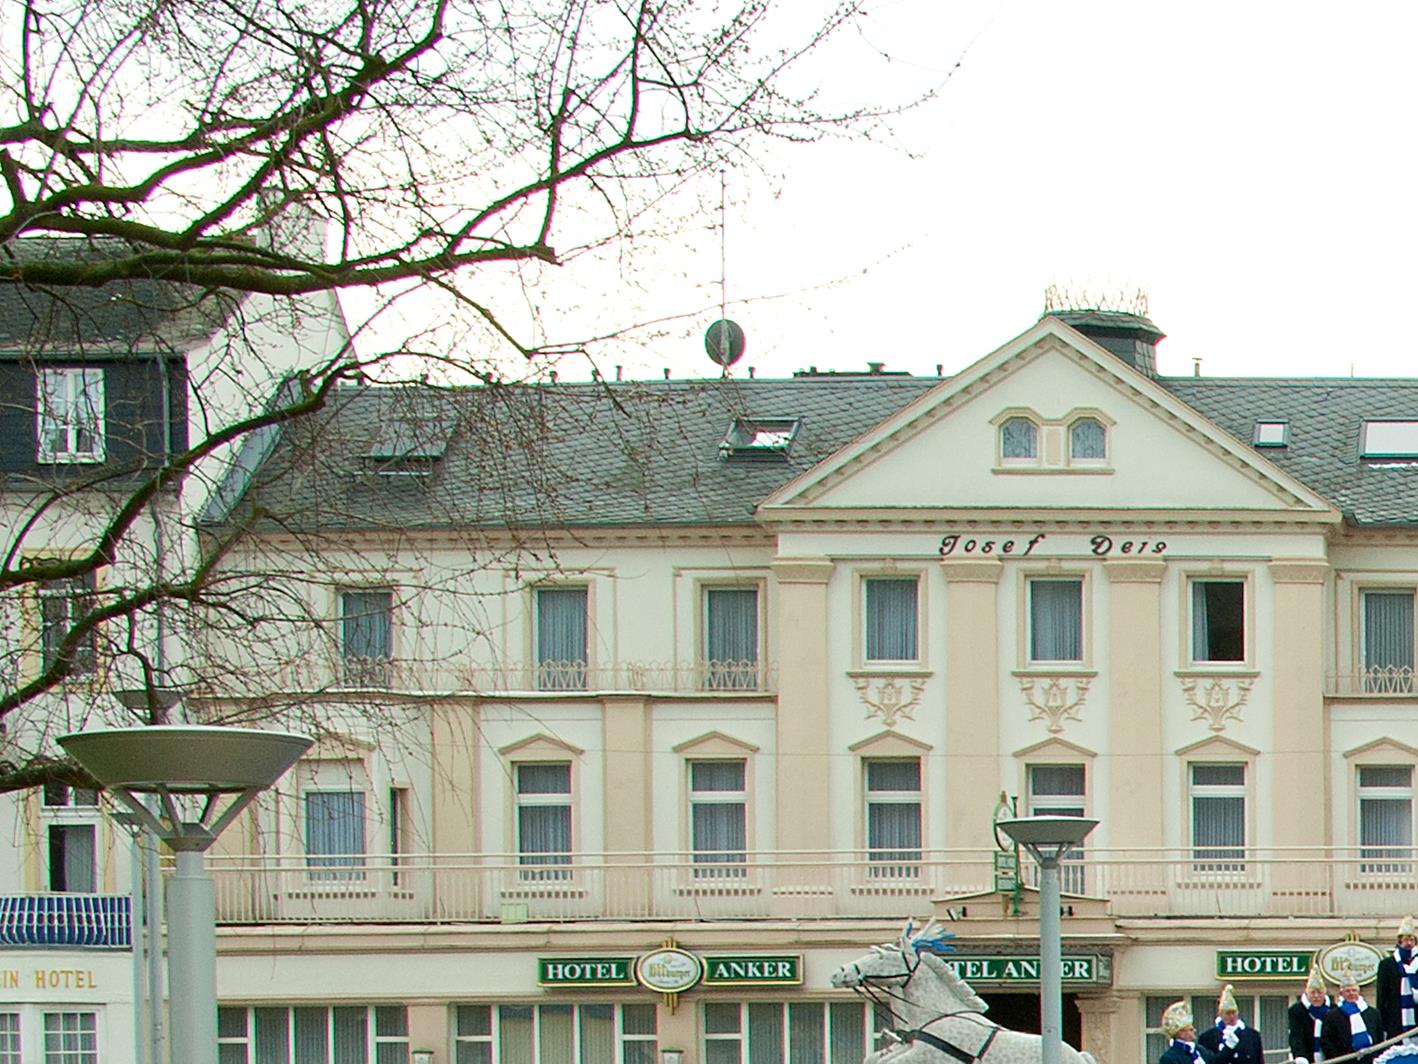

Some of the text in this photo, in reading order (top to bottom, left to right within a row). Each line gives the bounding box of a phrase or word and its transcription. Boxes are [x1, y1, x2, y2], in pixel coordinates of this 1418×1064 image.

[939, 534, 1045, 556] Josef
[546, 962, 792, 980] HOTEL ANKER
[947, 961, 1090, 978] TEL ANER
[1226, 956, 1307, 973] HOTEL
[0, 970, 97, 989] IN HOTEL
